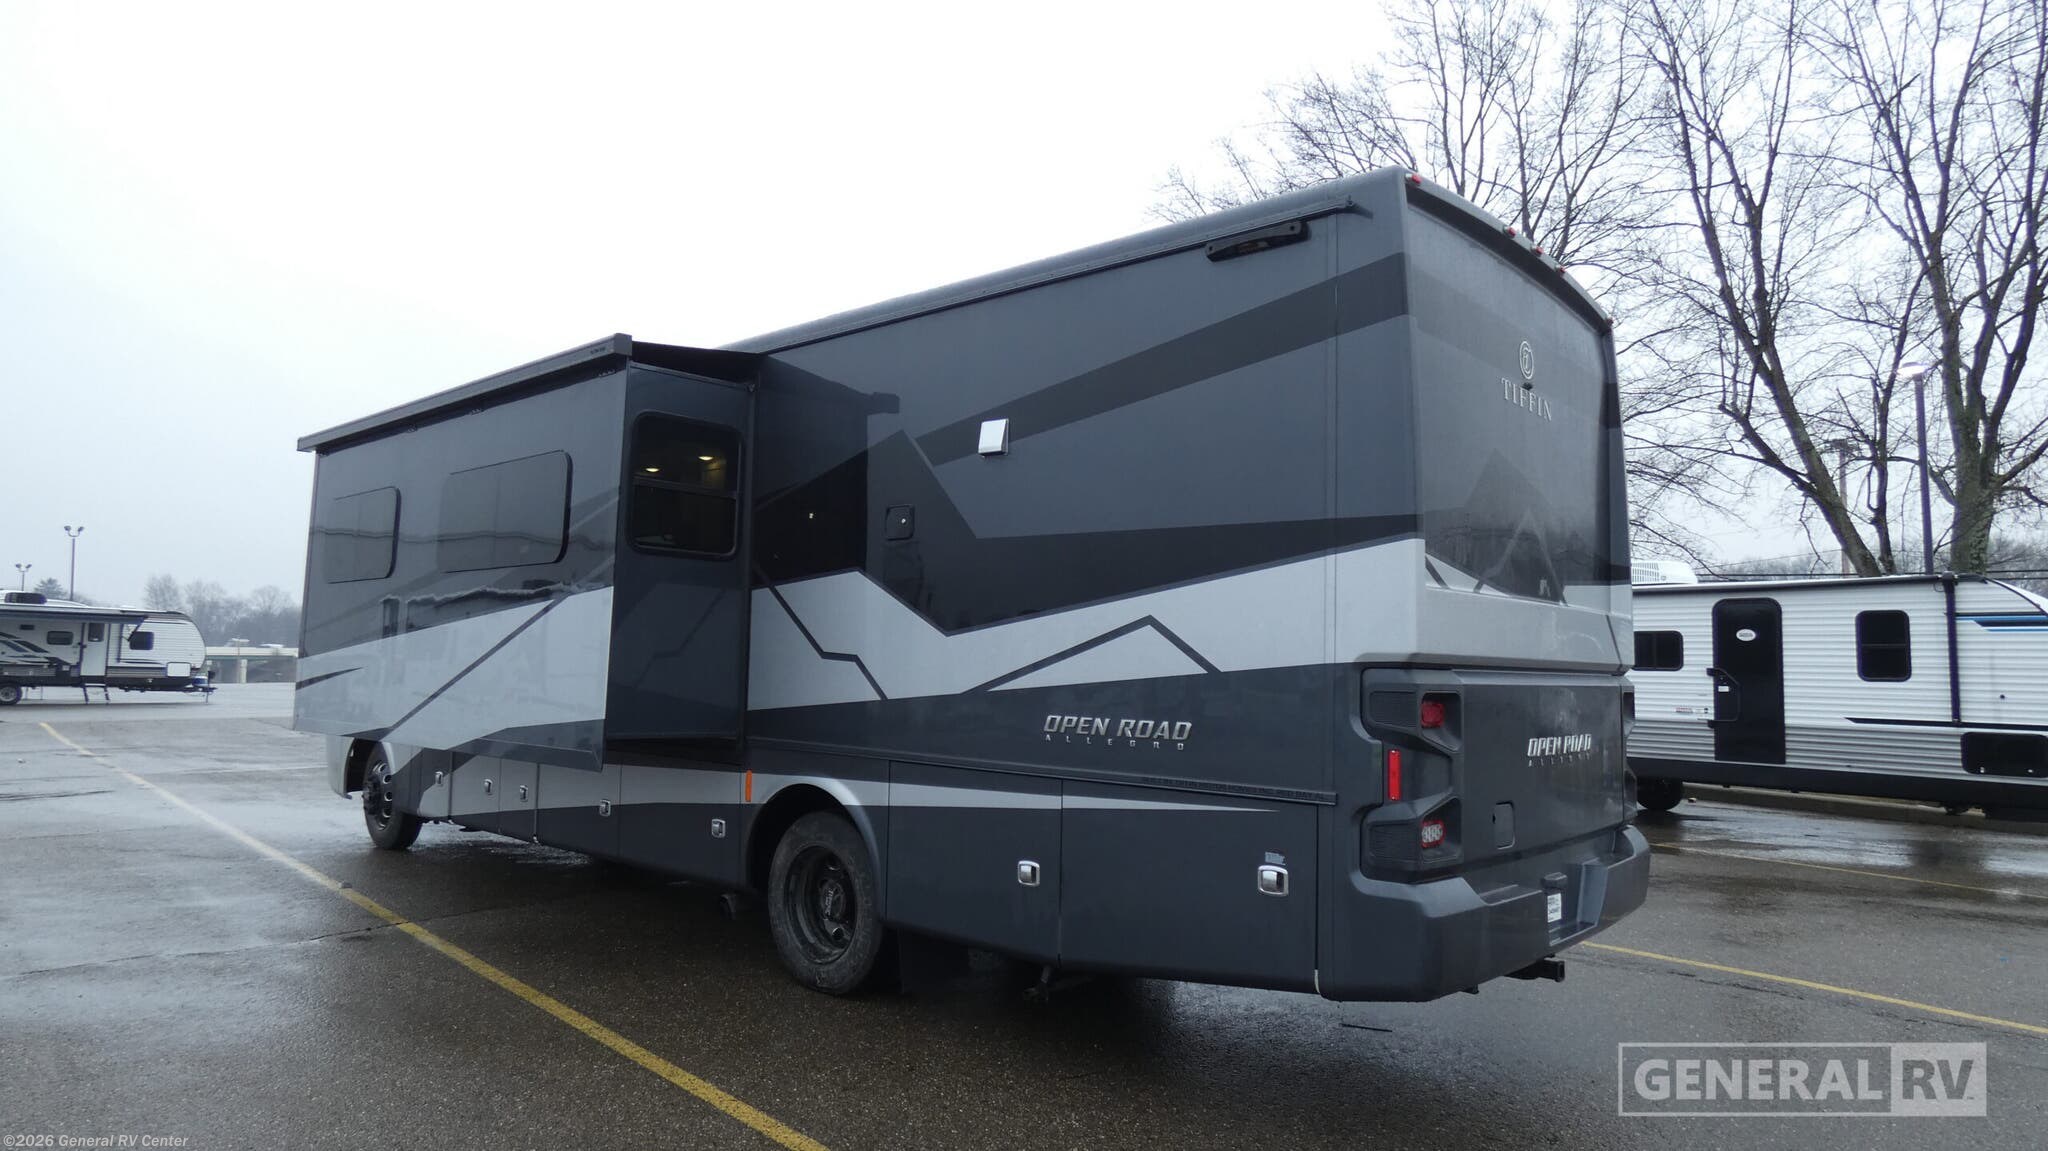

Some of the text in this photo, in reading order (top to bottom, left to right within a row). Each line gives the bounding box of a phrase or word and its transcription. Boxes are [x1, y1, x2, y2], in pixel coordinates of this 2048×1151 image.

[1501, 376, 1552, 421] TIFFIN
[1043, 714, 1192, 740] OPEN ROAD
[1045, 733, 1185, 751] ALLEGRO
[1527, 733, 1592, 757] OPEN ROAD
